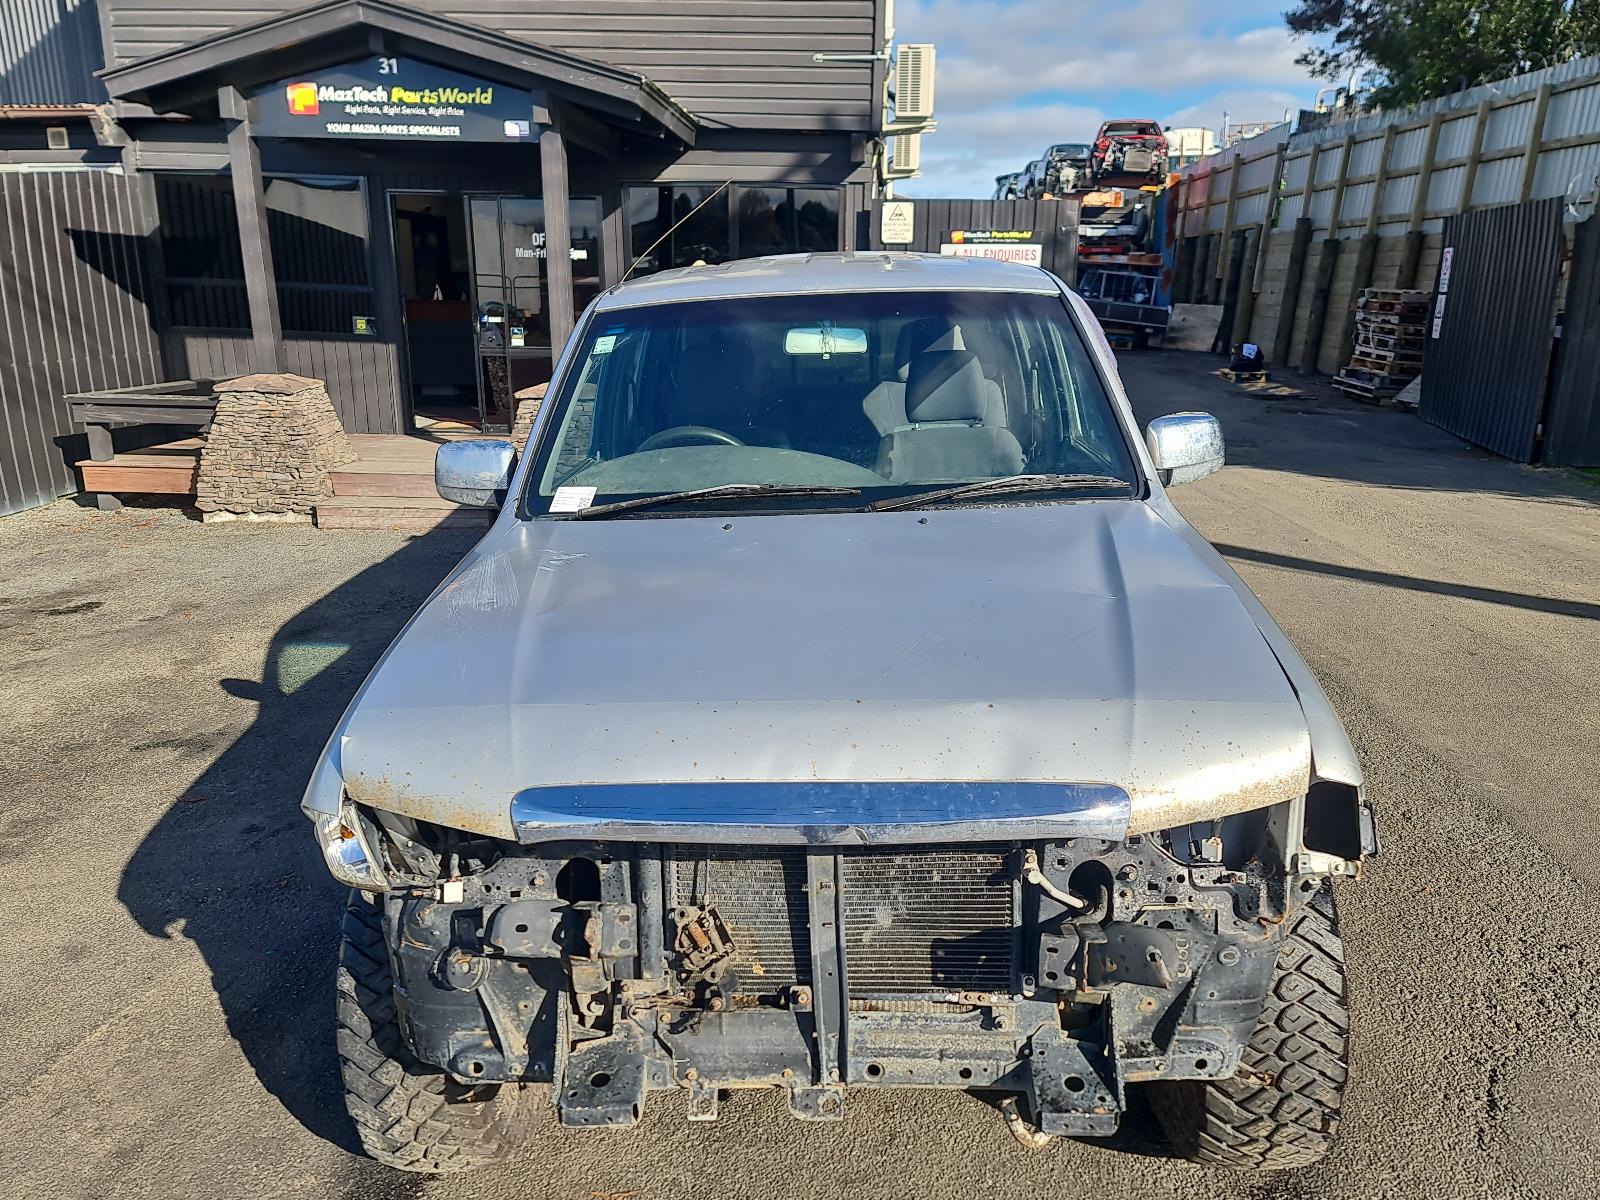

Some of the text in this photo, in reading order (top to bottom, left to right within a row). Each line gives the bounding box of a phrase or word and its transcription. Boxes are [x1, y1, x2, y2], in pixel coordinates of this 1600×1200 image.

[378, 57, 398, 74] 31
[318, 85, 493, 105] MazTech PartsWorld
[325, 123, 460, 136] YOUR MAZDA PARTS SPECIALISTS
[984, 249, 1037, 262] ENQUIRIES
